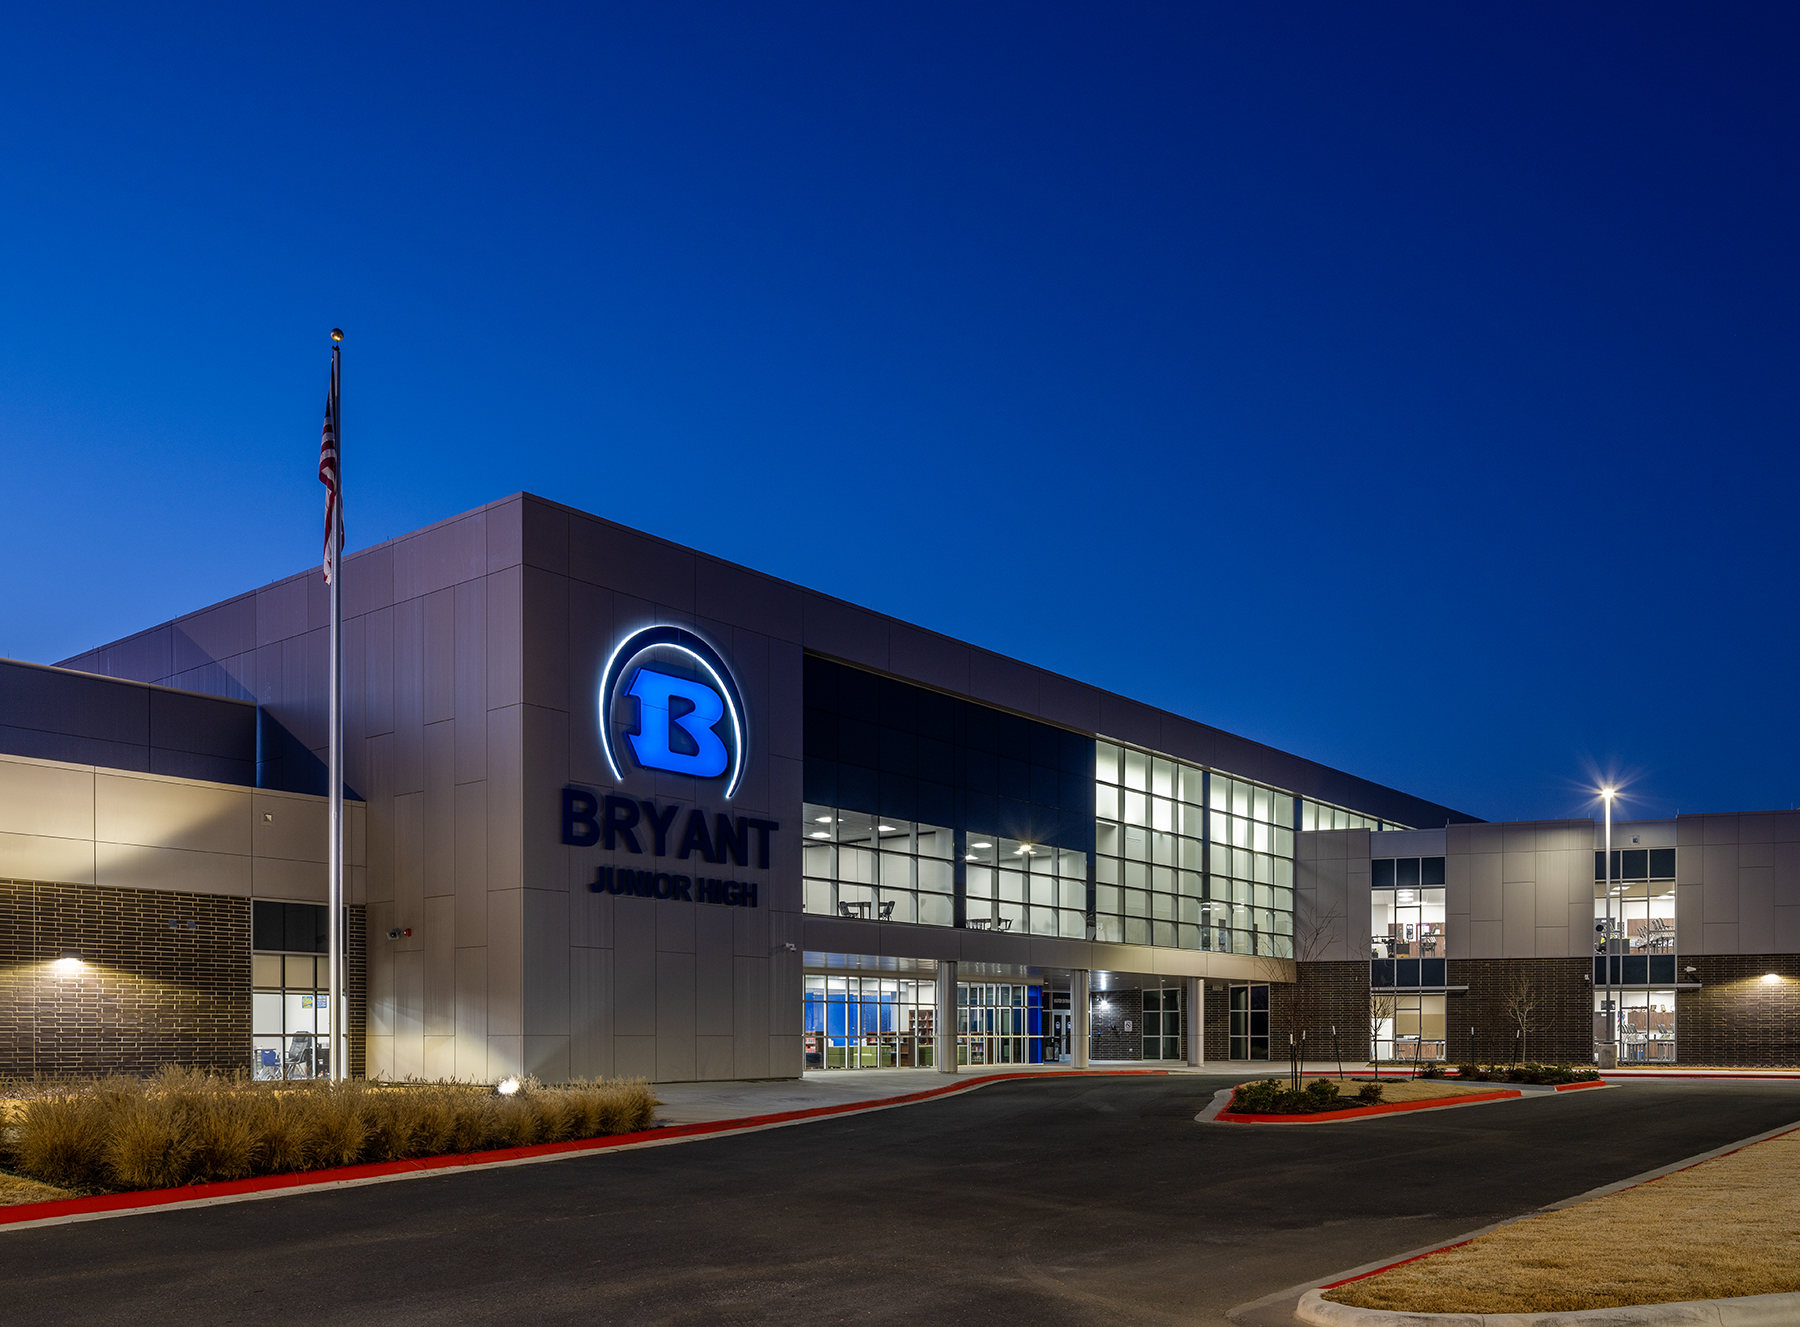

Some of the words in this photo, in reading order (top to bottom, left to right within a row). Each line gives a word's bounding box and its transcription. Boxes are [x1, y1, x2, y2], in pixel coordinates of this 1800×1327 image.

[623, 667, 728, 778] B
[561, 787, 779, 869] BRYANT
[590, 866, 692, 902] JUNIOR
[696, 877, 758, 908] HIGH
